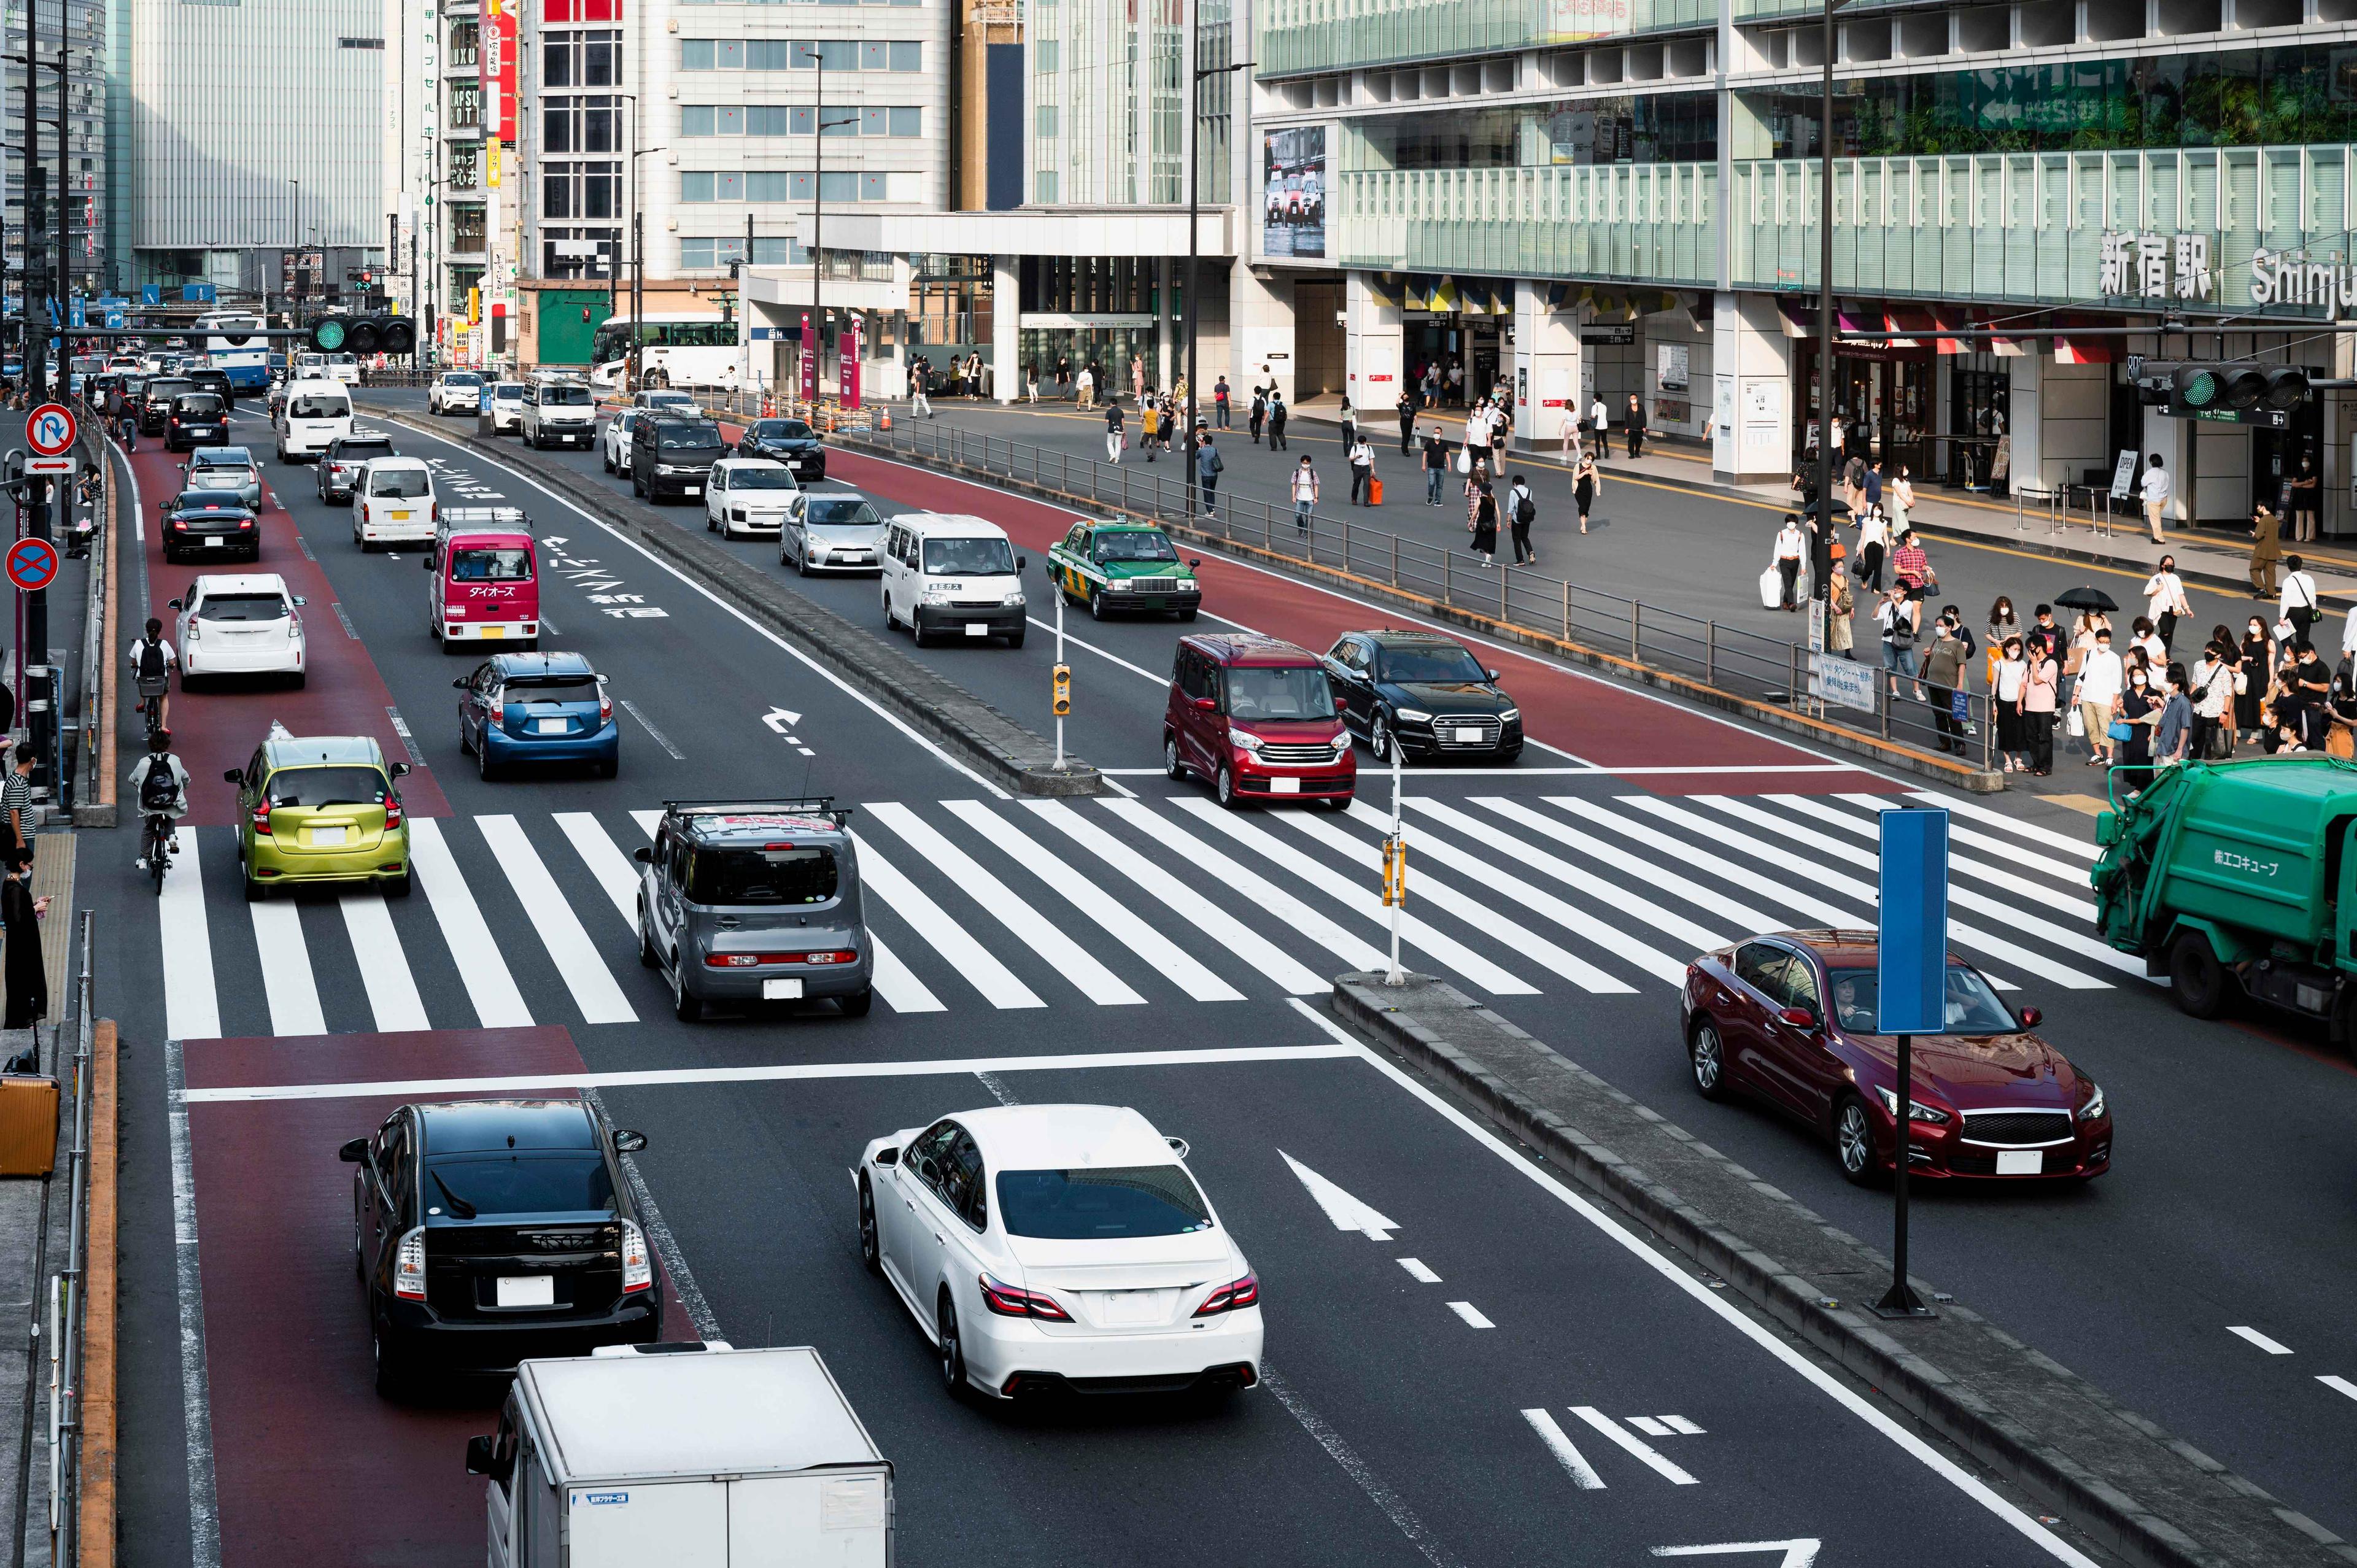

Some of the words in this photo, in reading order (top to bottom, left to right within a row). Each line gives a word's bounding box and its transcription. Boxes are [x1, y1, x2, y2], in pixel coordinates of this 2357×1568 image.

[2100, 230, 2212, 299] 新宿駅
[2119, 457, 2134, 469] OPEN
[470, 587, 516, 598] ダイオーズ
